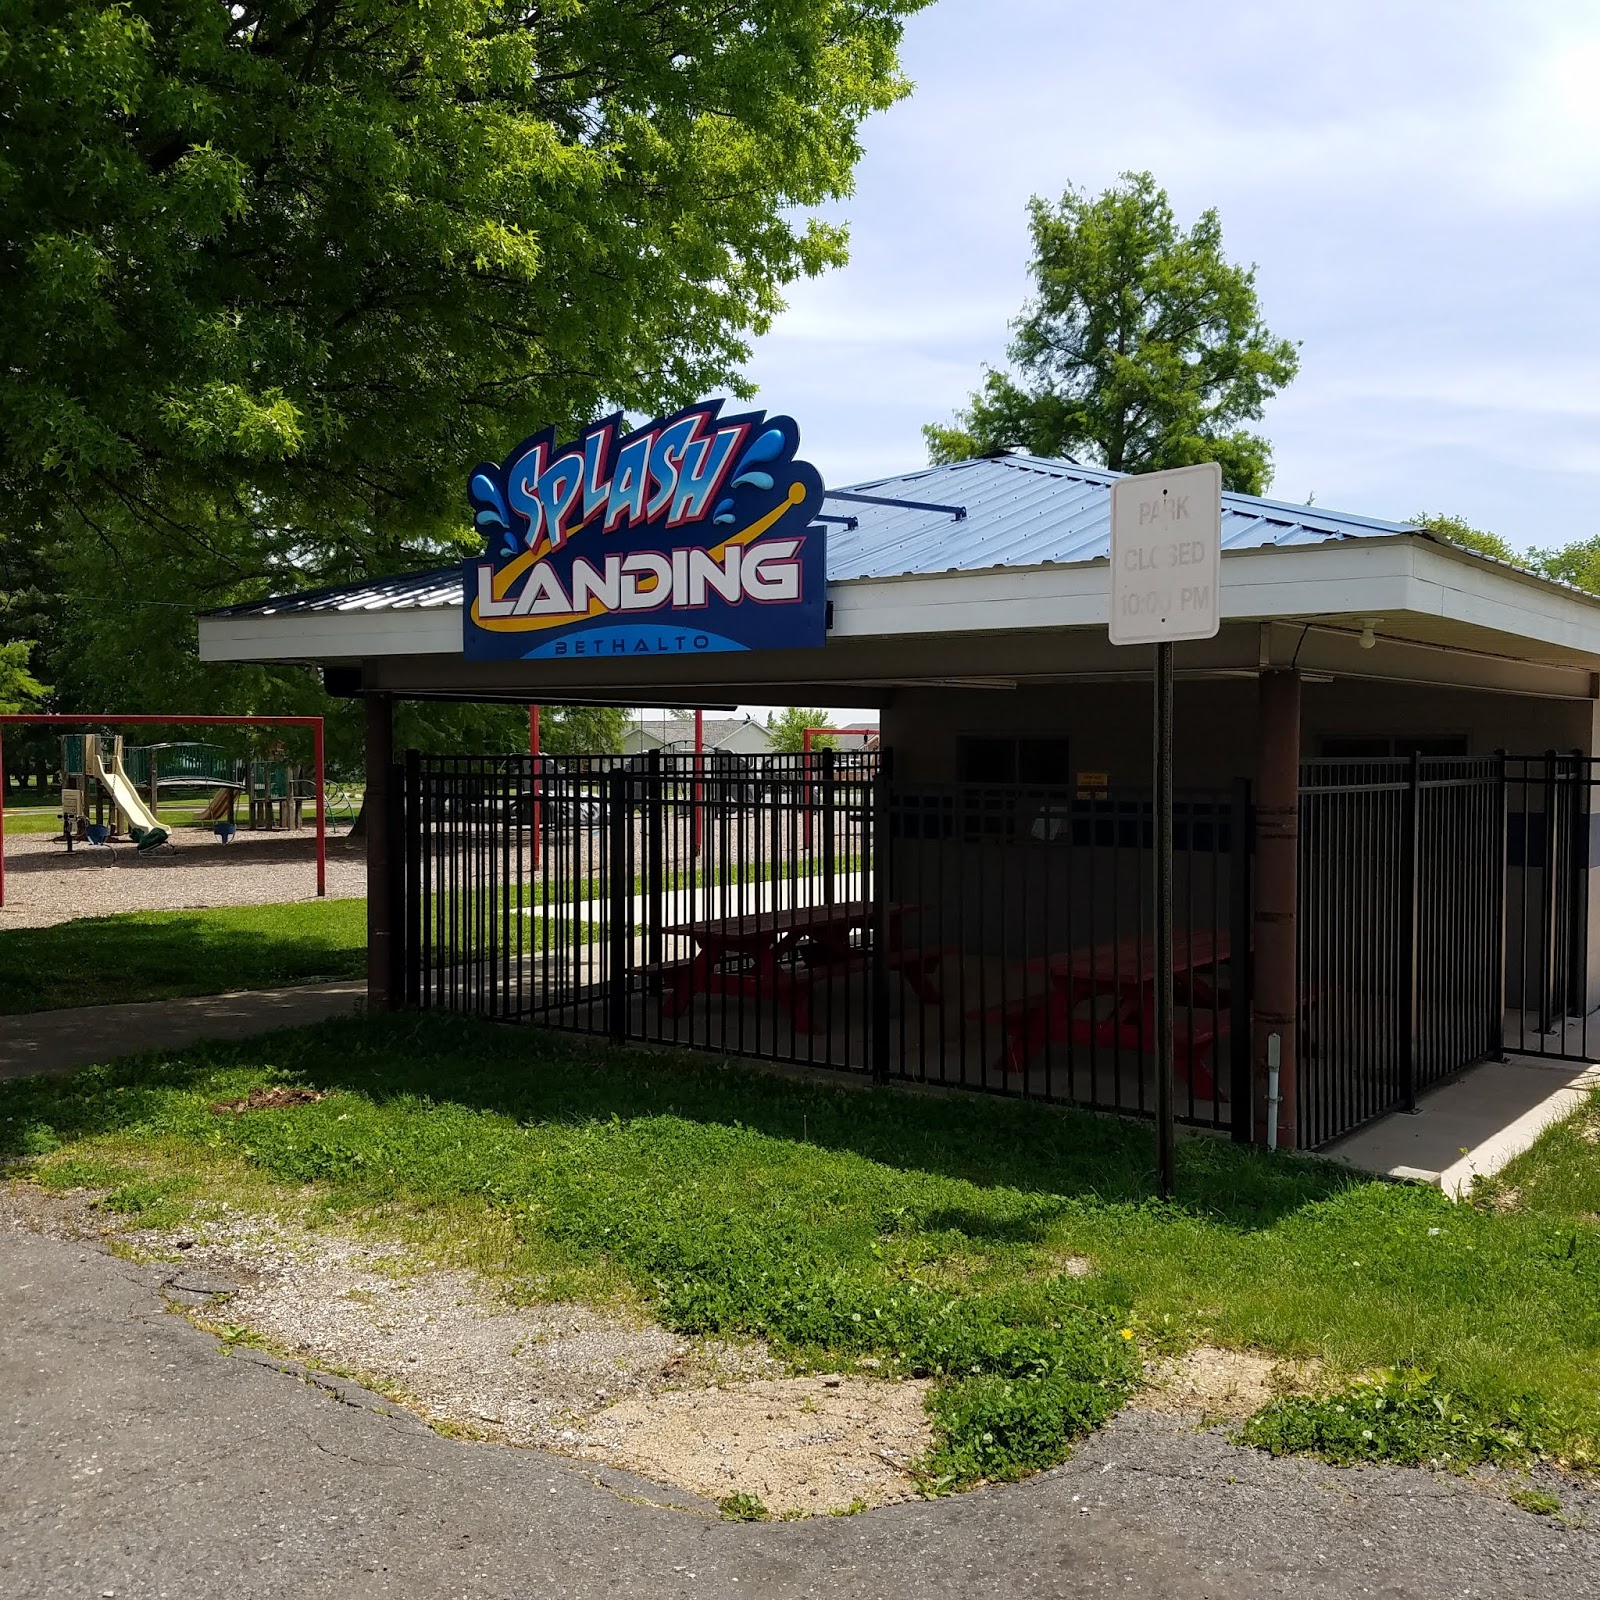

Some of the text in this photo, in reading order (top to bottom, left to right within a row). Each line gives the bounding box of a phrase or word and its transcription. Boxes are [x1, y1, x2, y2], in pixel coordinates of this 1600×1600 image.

[508, 411, 751, 555] SPLASH
[477, 536, 806, 621] LANDING
[1180, 586, 1209, 611] PM
[554, 635, 710, 656] BETHALTO
